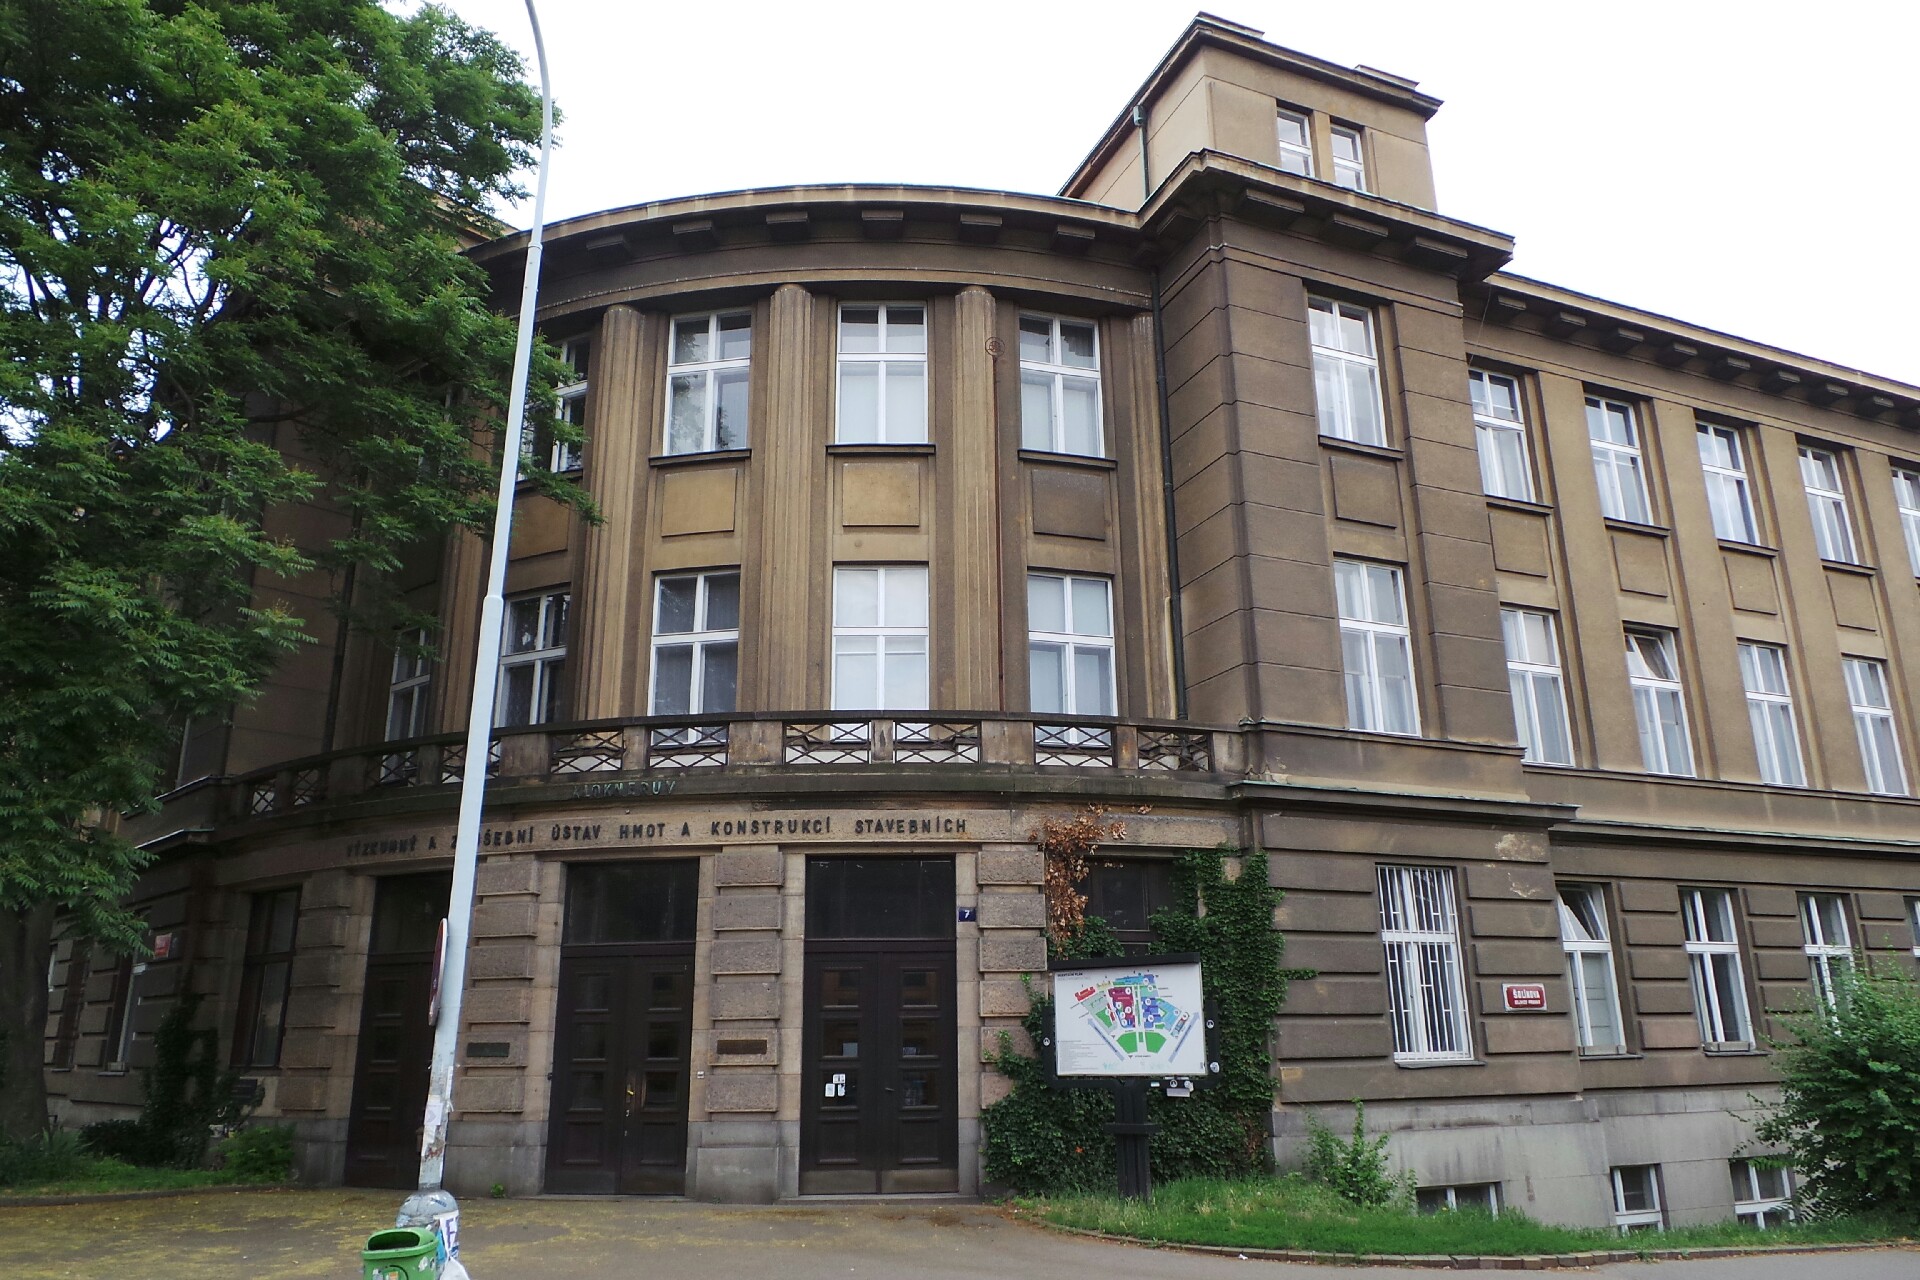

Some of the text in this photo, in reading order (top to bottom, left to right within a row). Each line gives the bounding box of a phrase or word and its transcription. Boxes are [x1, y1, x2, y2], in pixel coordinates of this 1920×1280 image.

[428, 836, 437, 851] A
[551, 823, 600, 841] ÚSTAV
[619, 823, 665, 839] HMOT
[681, 821, 690, 837] A
[711, 816, 831, 836] KONSTRUKCÍ
[854, 816, 966, 834] STAVEBNÍCH
[964, 909, 970, 919] 7
